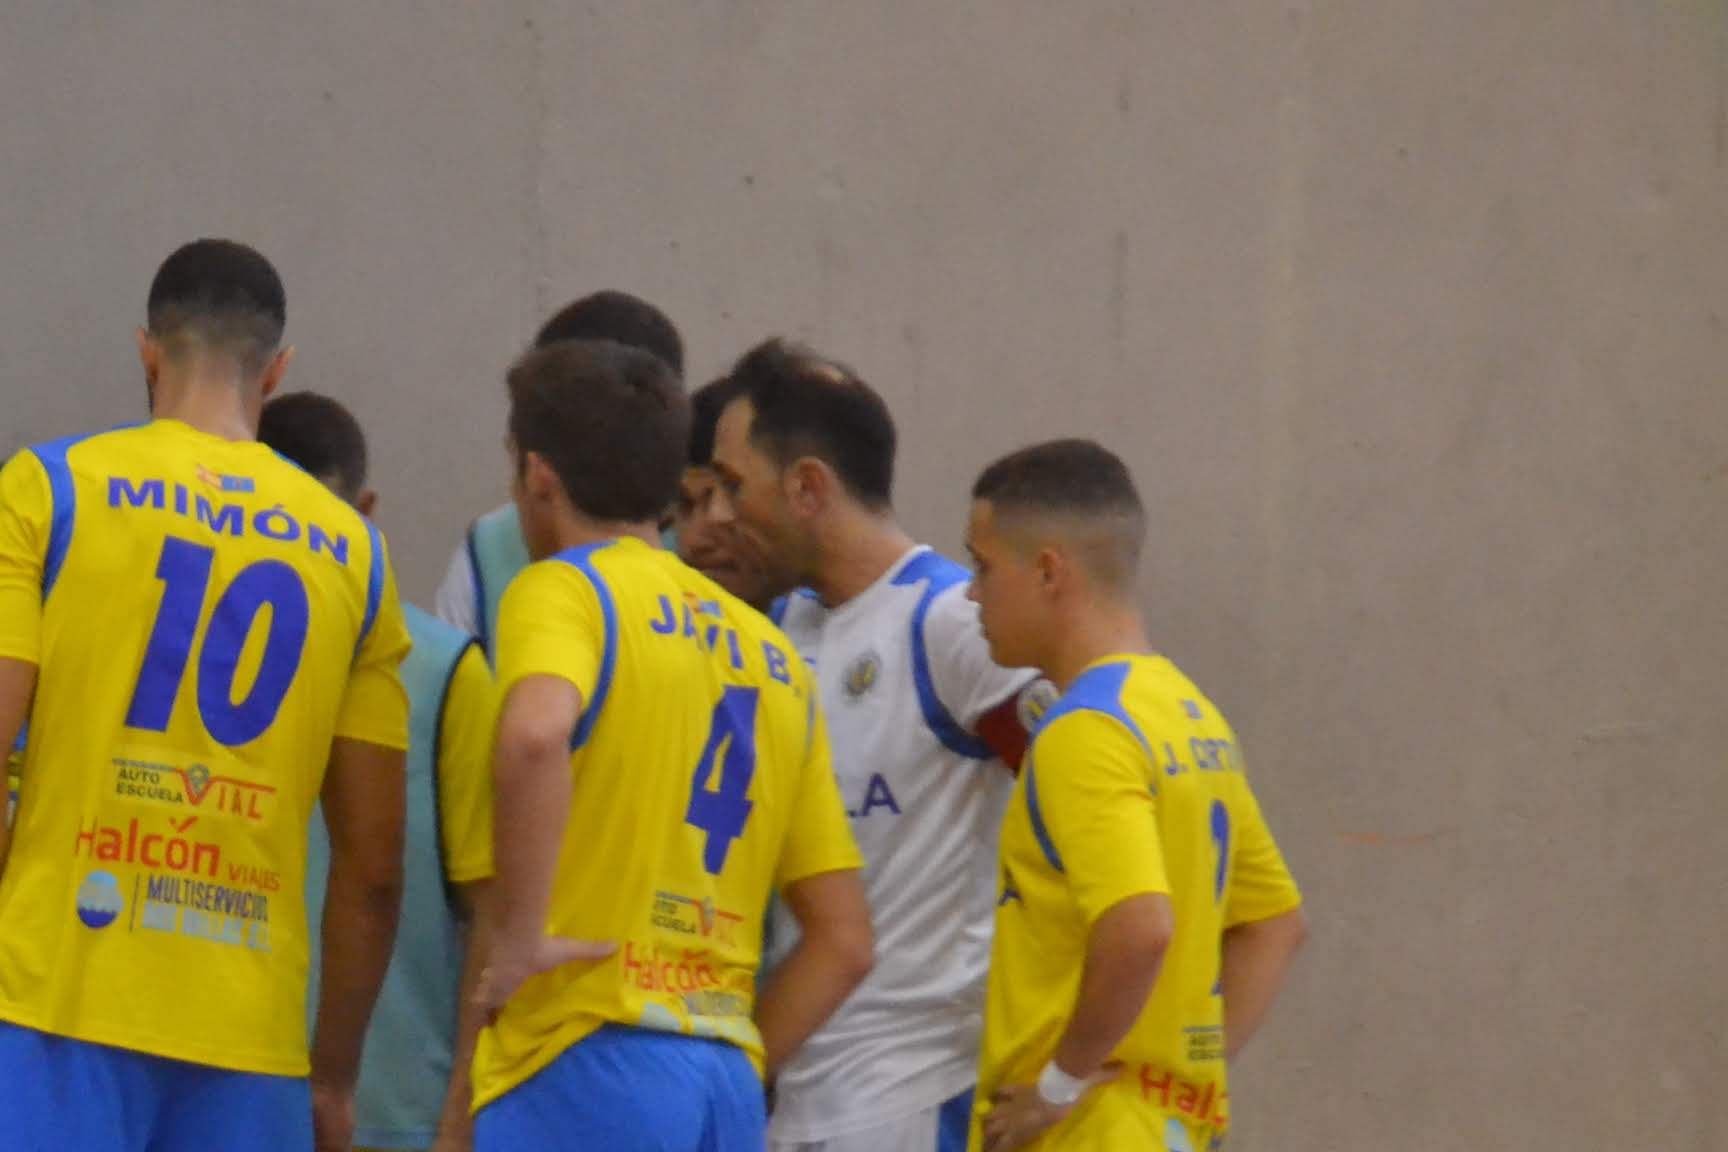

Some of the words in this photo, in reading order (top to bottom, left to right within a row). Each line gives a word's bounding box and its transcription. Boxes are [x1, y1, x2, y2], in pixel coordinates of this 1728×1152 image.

[106, 476, 349, 566] MIMÓN
[123, 534, 310, 747] 10
[115, 782, 184, 804] ESCUELA
[117, 767, 161, 785] AUTO
[685, 685, 760, 876] 4
[73, 815, 222, 878] Halcón
